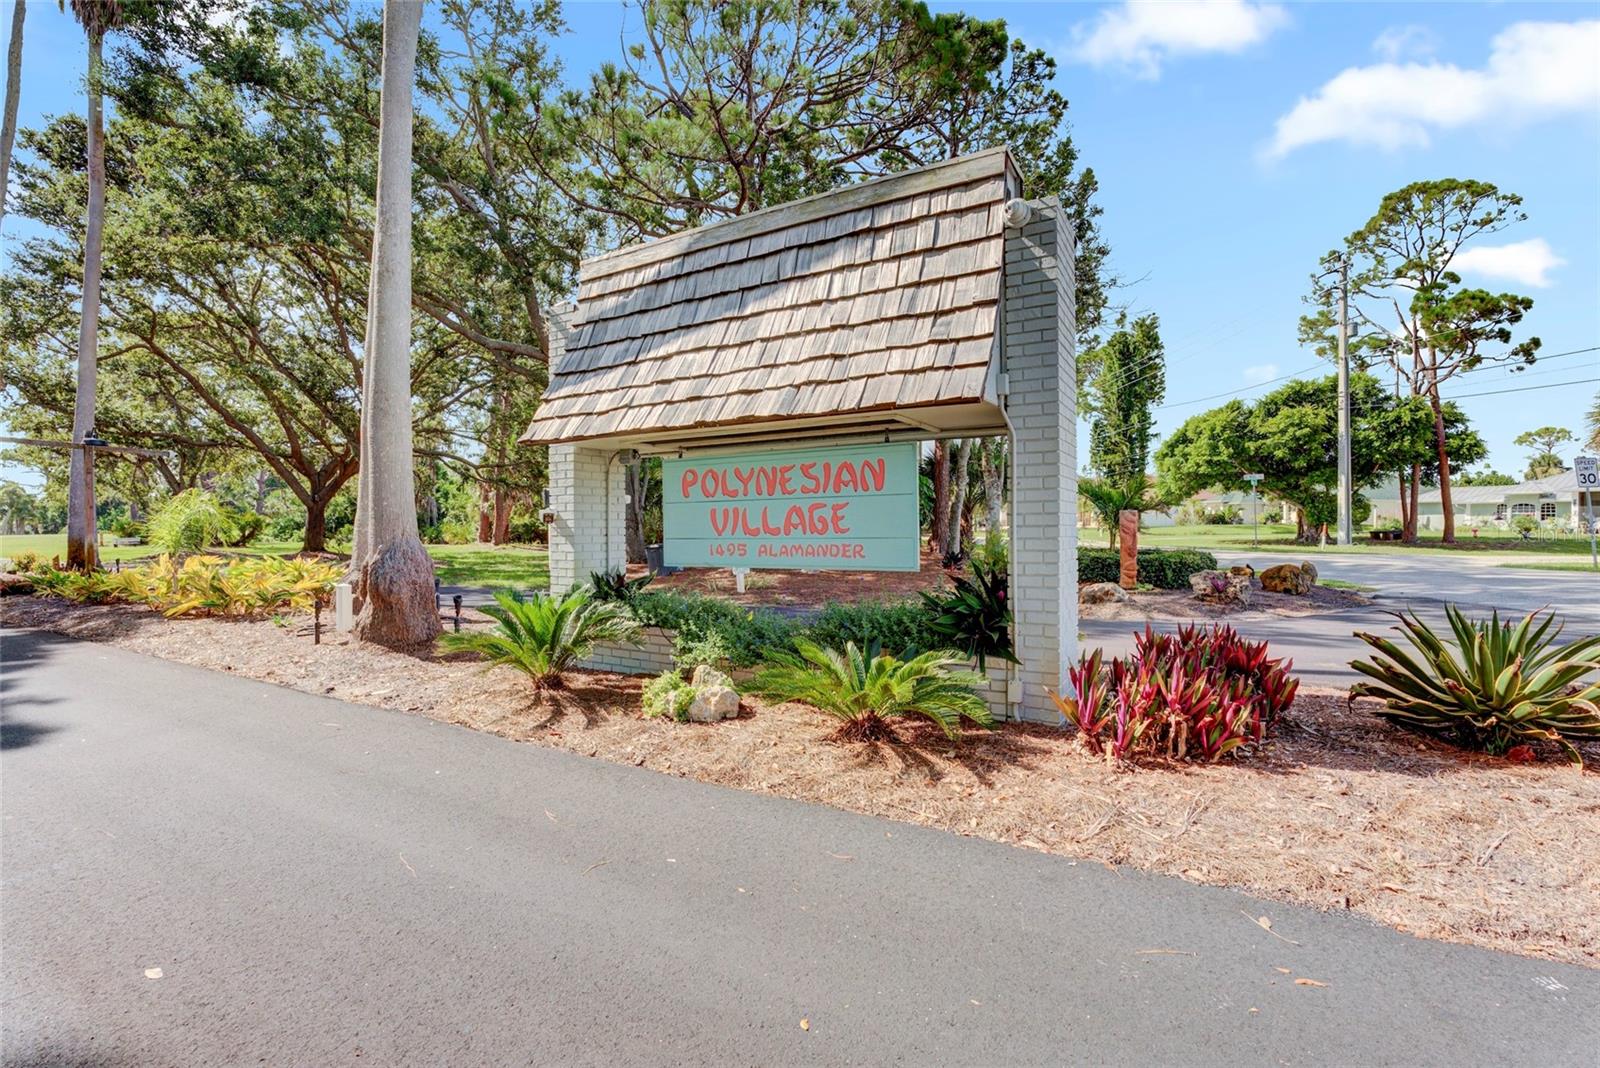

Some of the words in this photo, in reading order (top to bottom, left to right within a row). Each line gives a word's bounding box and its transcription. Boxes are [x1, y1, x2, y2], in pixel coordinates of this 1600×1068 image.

[682, 458, 885, 498] POLYNESIAN
[1579, 473, 1596, 484] 30
[710, 502, 850, 537] VILLAGE
[710, 543, 747, 557] 1495
[758, 543, 865, 559] ALAMANDER
